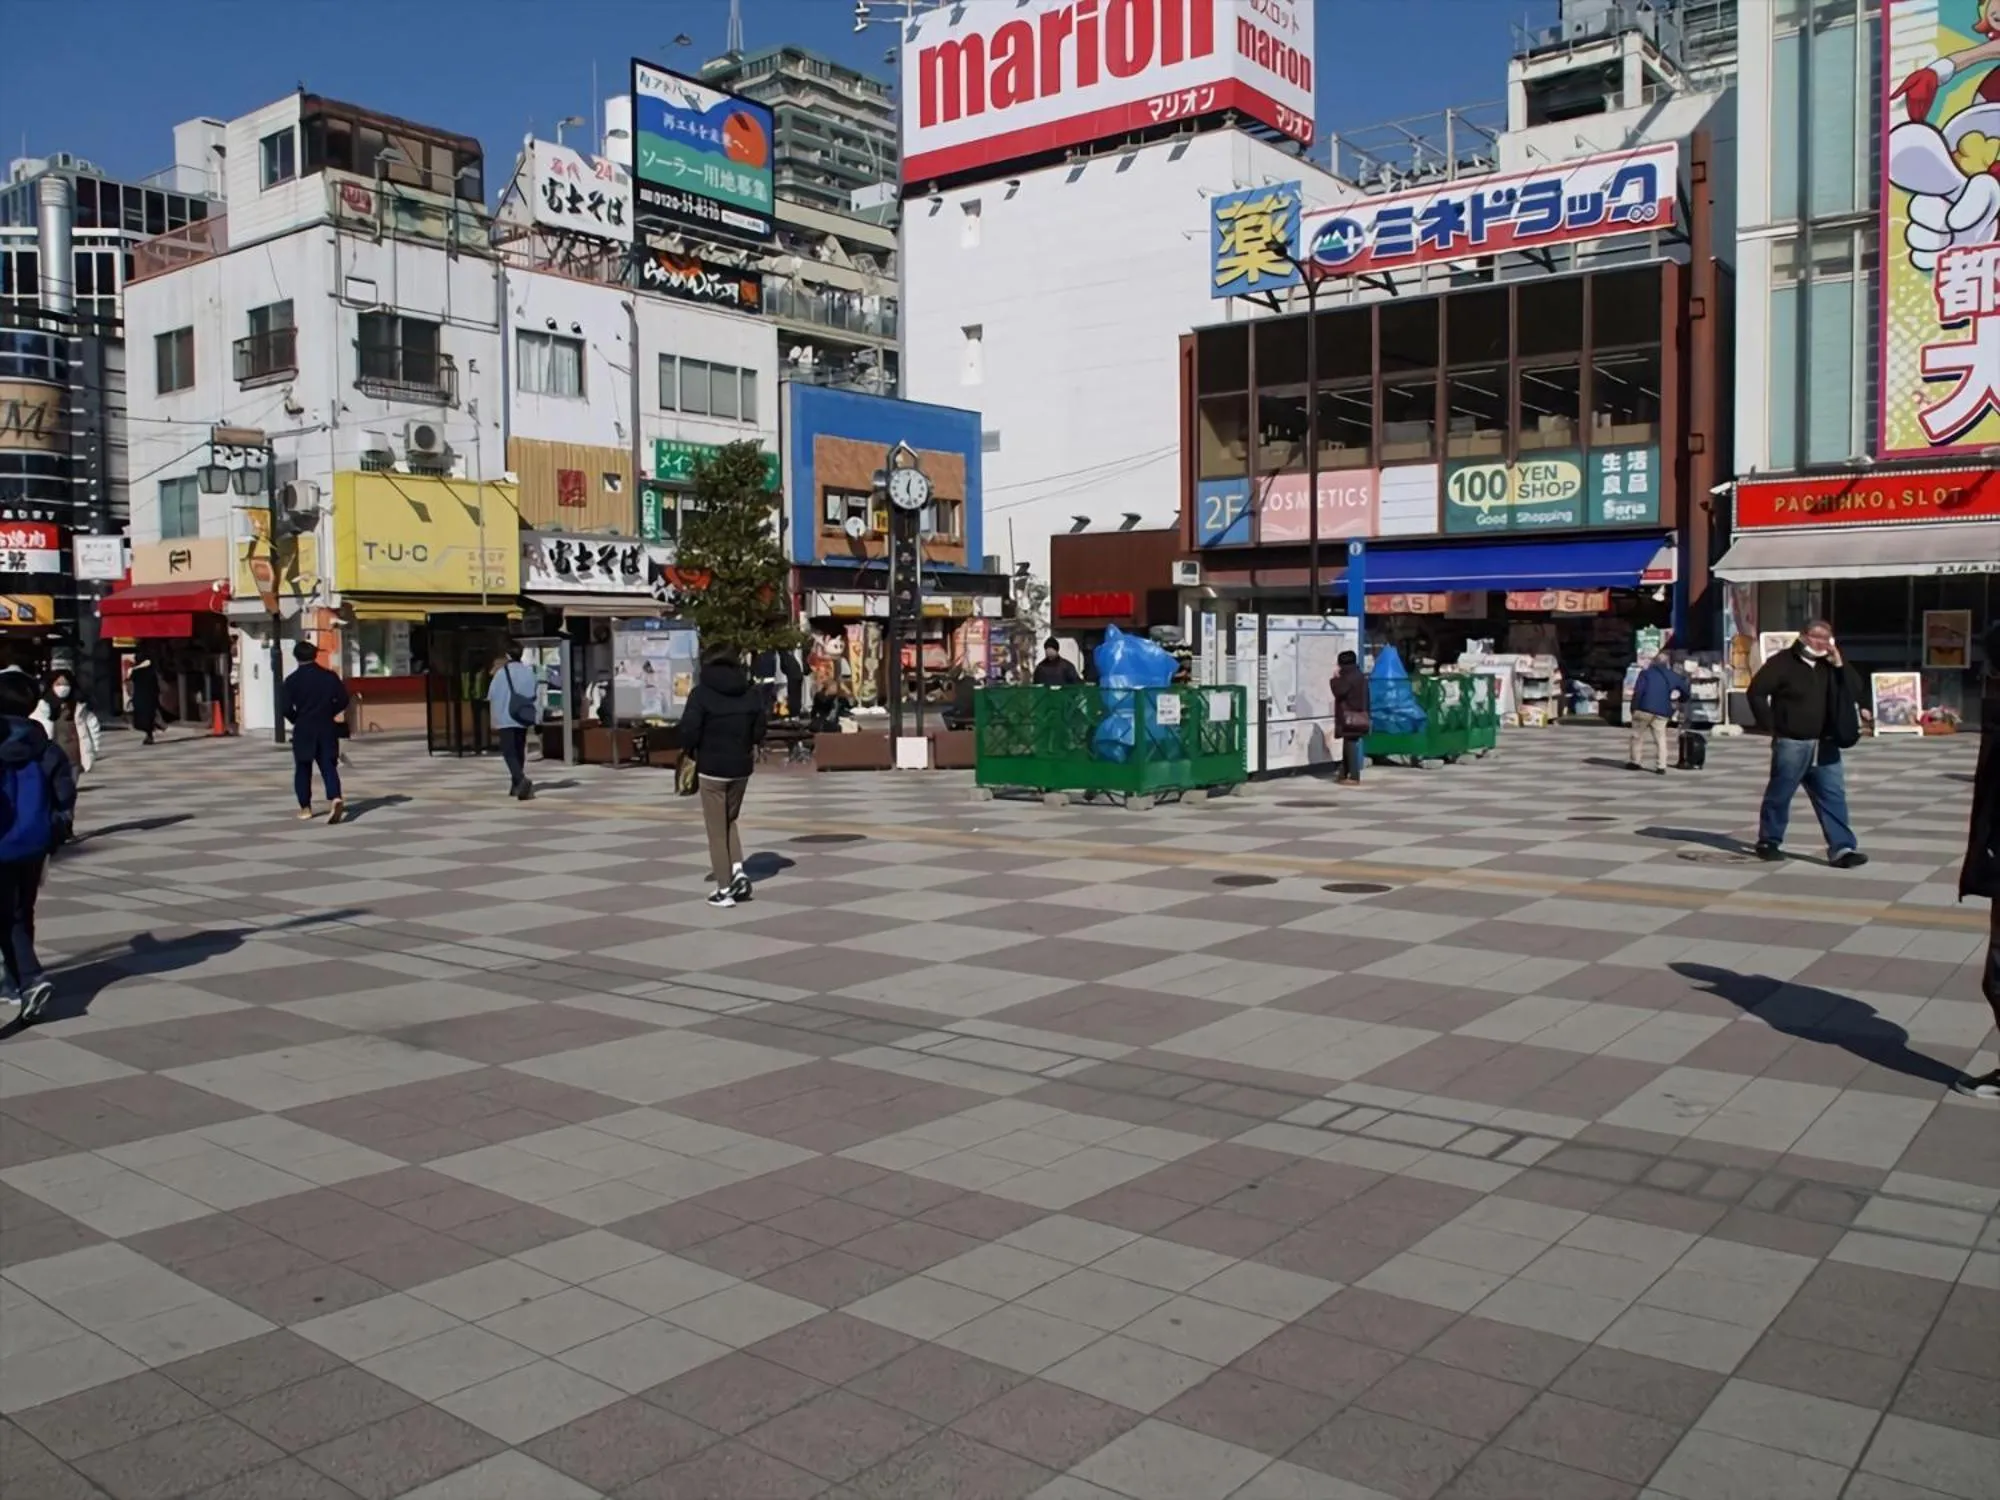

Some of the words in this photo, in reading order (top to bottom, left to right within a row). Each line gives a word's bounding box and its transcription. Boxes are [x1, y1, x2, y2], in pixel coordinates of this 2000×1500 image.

[919, 0, 1214, 128] marion
[1237, 15, 1311, 93] marion
[1148, 88, 1215, 121] マリオン
[1275, 104, 1313, 141] マリオン
[541, 177, 627, 226] 富士そば
[1214, 196, 1293, 287] 薬
[1453, 469, 1507, 502] 100
[1517, 465, 1558, 481] YEN
[1517, 480, 1575, 499] SHOP
[1775, 491, 1883, 513] PACHINKO
[1902, 487, 1962, 507] SLOT
[1204, 494, 1243, 530] 2F
[1475, 513, 1508, 526] Good
[1516, 510, 1573, 524] Shopping
[549, 540, 640, 576] 富士そば
